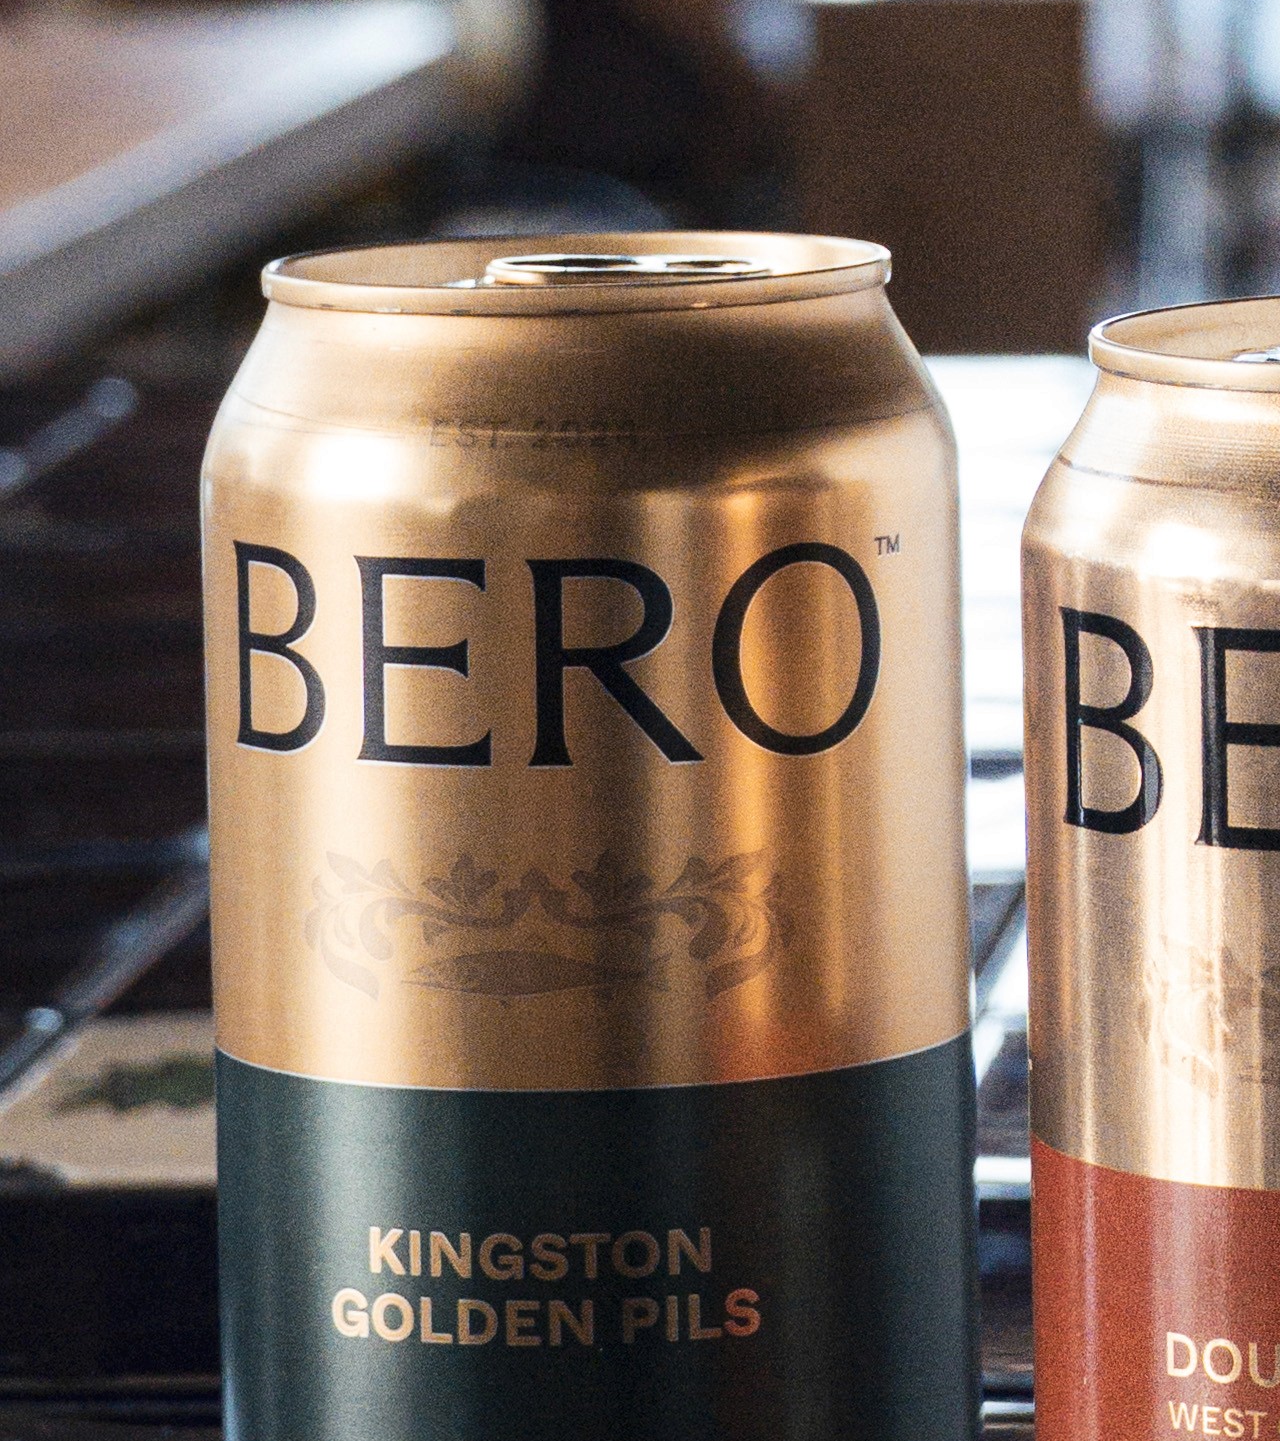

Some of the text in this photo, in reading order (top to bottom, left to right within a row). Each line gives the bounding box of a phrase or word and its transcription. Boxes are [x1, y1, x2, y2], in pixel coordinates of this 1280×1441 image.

[232, 539, 882, 767] BERO
[369, 1226, 712, 1282] KINGSTON
[331, 1288, 762, 1347] GOLDEN PILS
[1167, 1399, 1267, 1439] WEST
